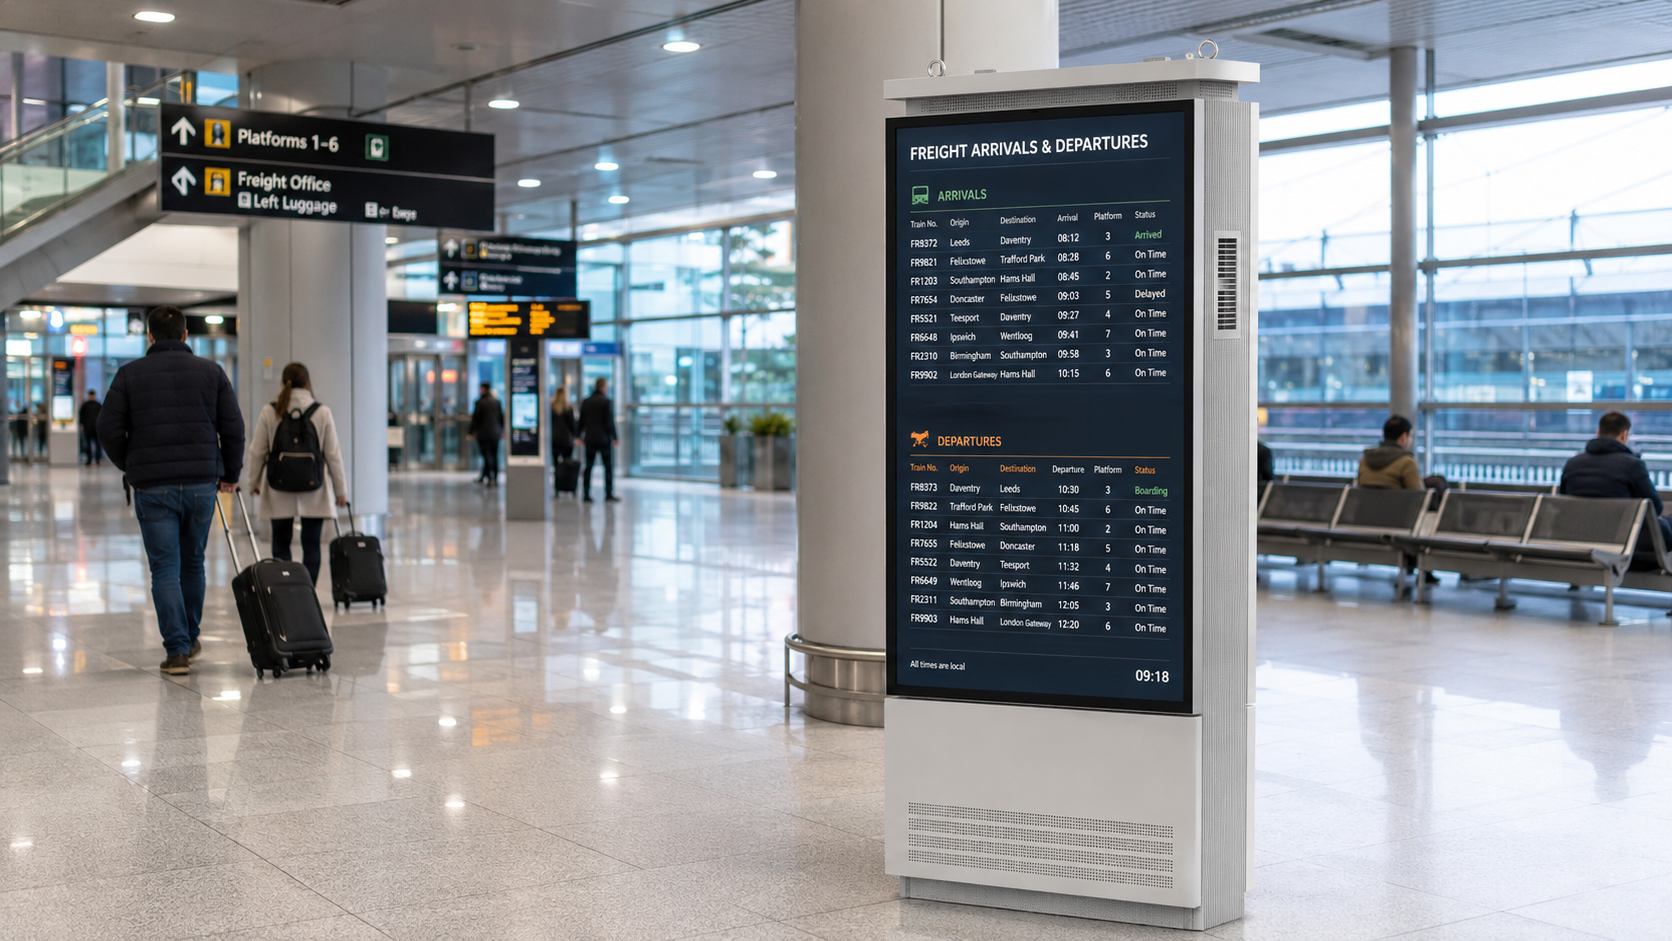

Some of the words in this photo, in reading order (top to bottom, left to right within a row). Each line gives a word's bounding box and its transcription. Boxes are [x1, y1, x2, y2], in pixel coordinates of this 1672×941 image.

[238, 128, 307, 149] Platforms
[911, 144, 968, 160] FREIGHT
[971, 140, 1037, 157] ARRIVALS
[1042, 140, 1051, 153] &
[1056, 134, 1148, 152] DEPARTURES
[238, 171, 287, 192] Freight
[290, 175, 331, 192] Office
[938, 188, 987, 201] ARRIVALS
[254, 194, 279, 209] Left
[283, 196, 337, 216] Luggage
[910, 220, 926, 228] Train
[927, 220, 938, 228] No.
[950, 218, 969, 228] Origin
[1000, 216, 1036, 224] Destination
[1057, 212, 1078, 222] Arrival
[1094, 212, 1122, 220] Platform
[1135, 210, 1156, 218] Status
[950, 238, 970, 246] Leeds
[1001, 236, 1031, 245] Daventry
[1058, 233, 1079, 242] 08:12
[1105, 232, 1111, 240] 3
[1135, 230, 1162, 239] Arrived
[911, 258, 937, 267] FR9821
[1000, 254, 1027, 263] Trafford
[1030, 254, 1045, 262] Park
[1058, 252, 1079, 262] 08:28
[1105, 251, 1111, 260] 6
[1135, 250, 1146, 259] On
[1148, 250, 1166, 258] Time
[911, 276, 937, 286] FR1203
[950, 276, 995, 285] Southampton
[1001, 274, 1020, 284] Hams
[1022, 273, 1035, 282] Hall
[1058, 272, 1079, 281] 08:45
[1105, 271, 1111, 279] 2
[1135, 270, 1146, 278] On
[1148, 270, 1166, 278] Time
[911, 296, 937, 304] FR7654
[950, 294, 984, 304] Doncaster
[1058, 291, 1079, 300] 09:03
[1105, 290, 1111, 299] 5
[1135, 289, 1165, 300] Delayed
[911, 314, 937, 323] FR5521
[950, 314, 979, 323] Teesport
[1001, 313, 1031, 322] Daventry
[1058, 310, 1079, 320] 09:27
[1105, 310, 1111, 318] 4
[1135, 309, 1146, 318] On
[1148, 308, 1166, 318] Time
[950, 332, 976, 343] Ipswich
[1000, 331, 1032, 341] Wentloog
[1058, 330, 1078, 339] 09:41
[1105, 329, 1111, 338] 7
[1135, 328, 1146, 338] On
[1148, 328, 1166, 338] Time
[911, 352, 938, 360] FR2310
[950, 352, 991, 362] Birmingham
[1000, 351, 1047, 360] Southampton
[1058, 349, 1079, 358] 09:58
[1105, 349, 1111, 358] 3
[1135, 348, 1146, 358] On
[1148, 348, 1166, 358] Time
[950, 370, 972, 380] London
[1000, 370, 1020, 378] Hams
[1022, 369, 1035, 378] Hall
[1059, 368, 1079, 378] 10:15
[1105, 369, 1111, 377] 6
[1135, 368, 1146, 377] On
[1148, 368, 1166, 377] Time
[938, 436, 1001, 446] DEPARTURES
[910, 462, 926, 472] Train
[927, 464, 938, 472] No.
[950, 464, 969, 473] Origin
[1000, 464, 1036, 472] Destination
[1053, 465, 1084, 474] Departure
[1094, 464, 1122, 474] Platform
[1135, 466, 1155, 474] Status
[911, 482, 937, 492] FR8373
[950, 483, 980, 494] Daventry
[1000, 484, 1020, 493] Leeds
[1059, 484, 1079, 494] 10:30
[1105, 486, 1111, 494] 3
[1135, 486, 1168, 497] Boarding
[911, 502, 937, 510] FR9822
[950, 502, 976, 511] Trafford
[978, 502, 993, 512] Park
[1059, 504, 1079, 514] 10:45
[1105, 505, 1111, 513] 6
[1135, 506, 1146, 514] On
[1147, 506, 1166, 514] Time
[911, 520, 937, 529] FR1204
[950, 520, 969, 530] Hams
[971, 522, 984, 530] Hall
[1000, 522, 1046, 533] Southampton
[1058, 524, 1079, 532] 11:00
[1105, 525, 1111, 533] 2
[1135, 525, 1146, 534] On
[1148, 526, 1166, 534] Time
[911, 539, 937, 548] FR7655
[1000, 541, 1035, 550] Doncaster
[1058, 542, 1079, 552] 11:18
[1105, 544, 1111, 553] 5
[1135, 544, 1146, 554] On
[1148, 545, 1166, 554] Time
[911, 557, 937, 566] FR5522
[950, 559, 980, 569] Daventry
[1000, 560, 1030, 570] Teesport
[1059, 562, 1079, 571] 11:32
[1105, 564, 1111, 572] 4
[1135, 564, 1146, 573] On
[1148, 565, 1166, 574] Time
[911, 576, 937, 585] FR6649
[950, 578, 982, 589] Wentloog
[1000, 579, 1026, 589] Ipswich
[1059, 581, 1079, 590] 11:46
[1105, 583, 1111, 591] 7
[1135, 584, 1146, 592] On
[1148, 584, 1166, 593] Time
[911, 595, 936, 604] FR2311
[950, 596, 995, 607] Southampton
[1000, 598, 1042, 610] Birmingham
[1058, 600, 1079, 610] 12:05
[1105, 602, 1111, 611] 3
[1135, 604, 1146, 612] On
[1148, 604, 1166, 613] Time
[950, 616, 969, 624] Hams
[971, 616, 984, 625] Hall
[1000, 618, 1024, 626] London
[1059, 620, 1079, 629] 12:20
[1105, 622, 1111, 630] 6
[1135, 623, 1146, 632] On
[1148, 624, 1166, 633] Time
[910, 660, 919, 668] All
[920, 660, 937, 670] times
[950, 662, 965, 670] local
[1136, 670, 1169, 682] 09:18
